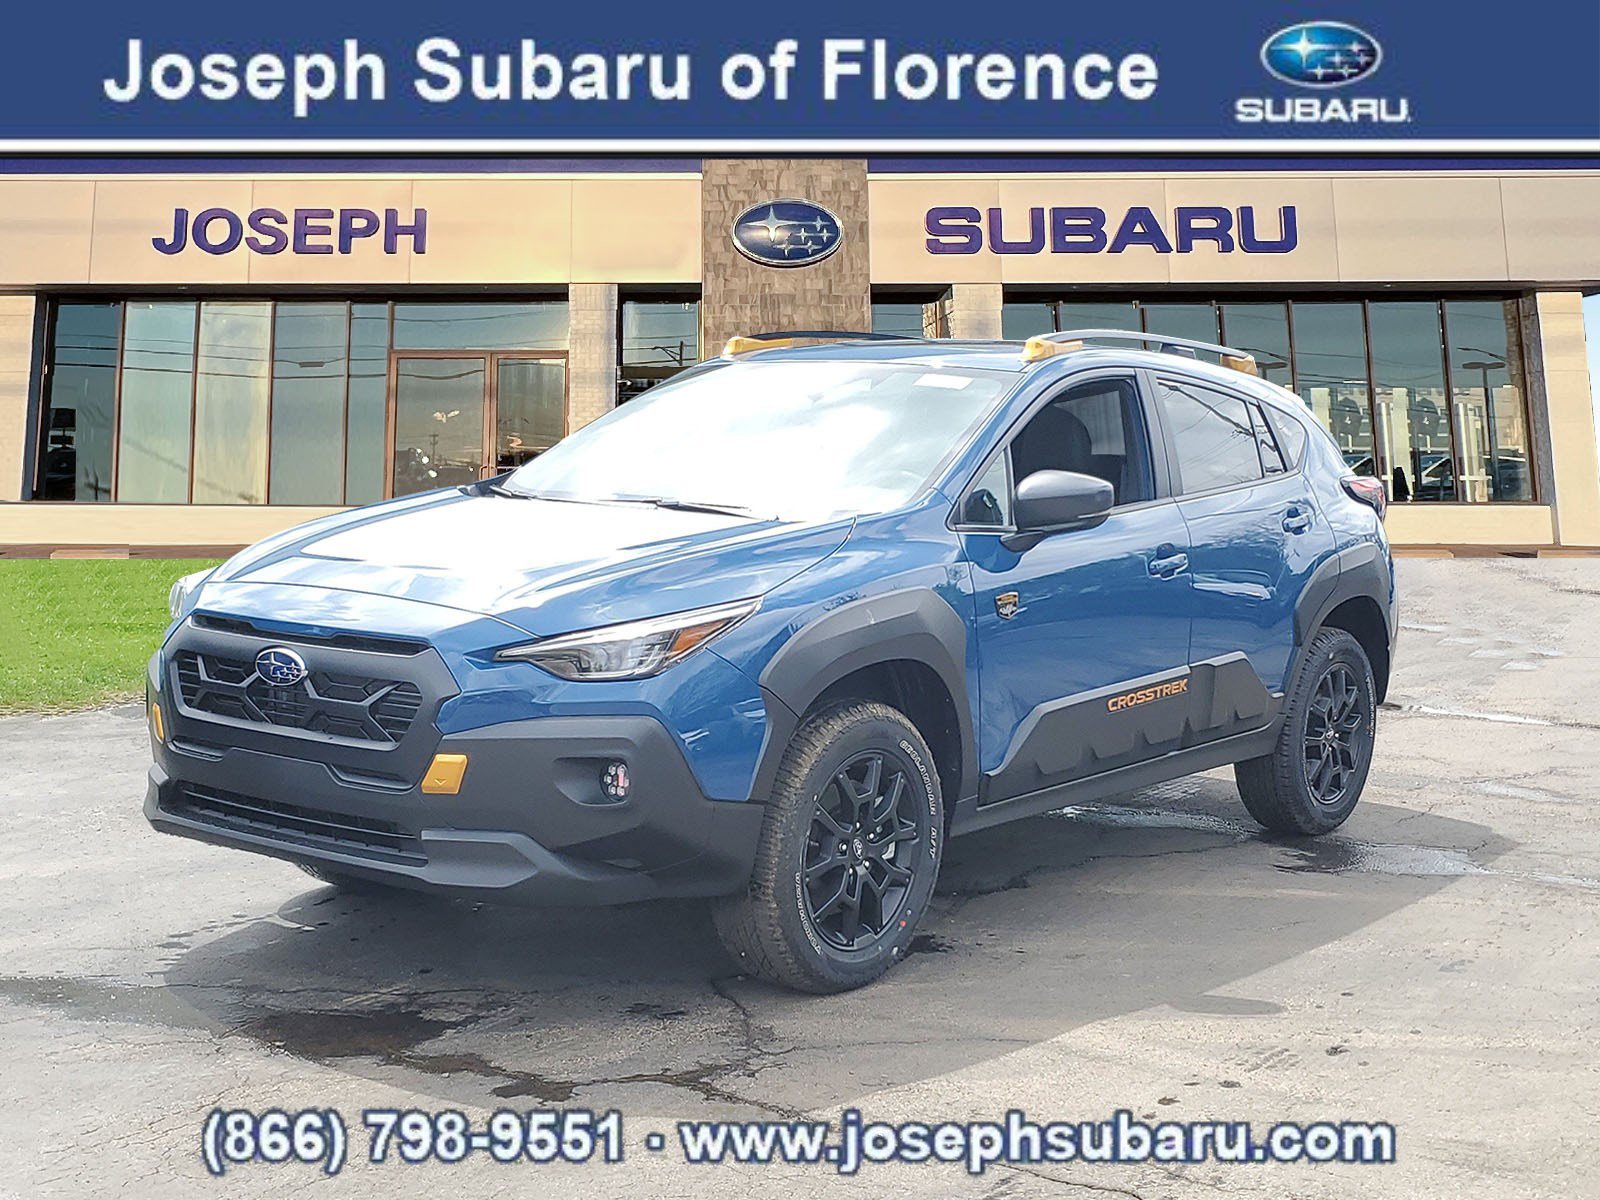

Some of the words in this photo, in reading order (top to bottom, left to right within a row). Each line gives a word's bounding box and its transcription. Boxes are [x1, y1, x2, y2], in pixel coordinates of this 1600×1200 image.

[152, 207, 428, 255] JOSEPH
[925, 205, 1298, 254] SUBARU
[1106, 678, 1188, 712] CROSSTREK
